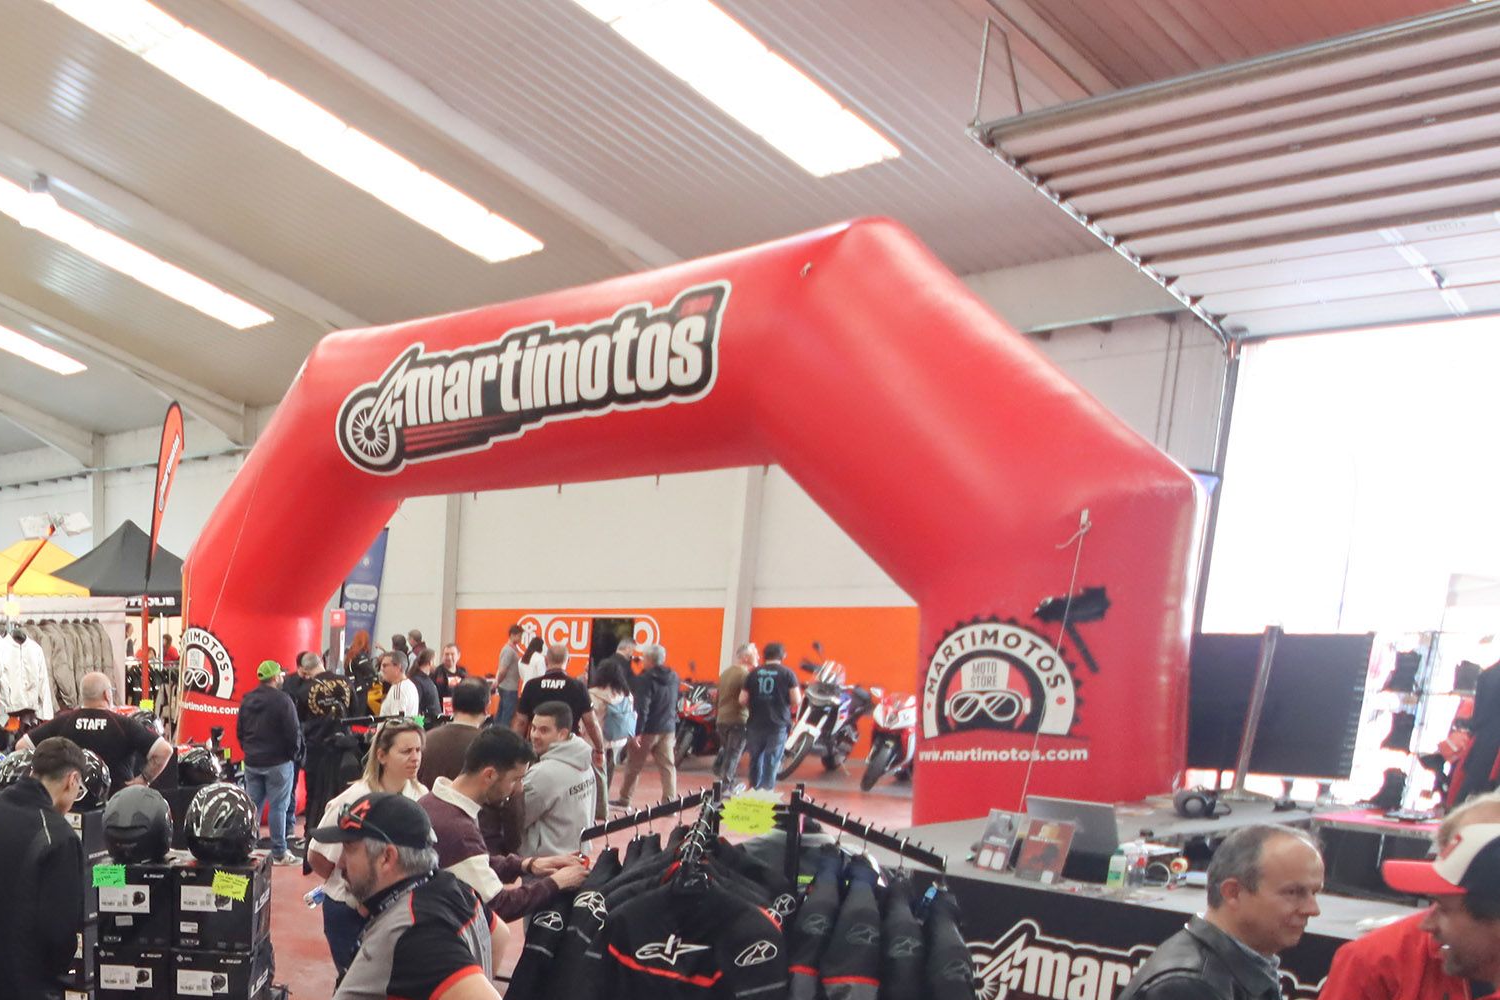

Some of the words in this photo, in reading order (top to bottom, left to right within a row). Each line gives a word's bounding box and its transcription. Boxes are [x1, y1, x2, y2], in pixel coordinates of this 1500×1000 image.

[394, 314, 707, 427] martimotos
[927, 629, 1066, 696] MARTIMOTOS
[972, 661, 997, 674] MOTO
[541, 679, 566, 689] STAFF
[757, 676, 775, 694] 10
[971, 674, 997, 688] STORE
[75, 718, 107, 730] STAFF
[918, 746, 1088, 762] www.martimotos.com
